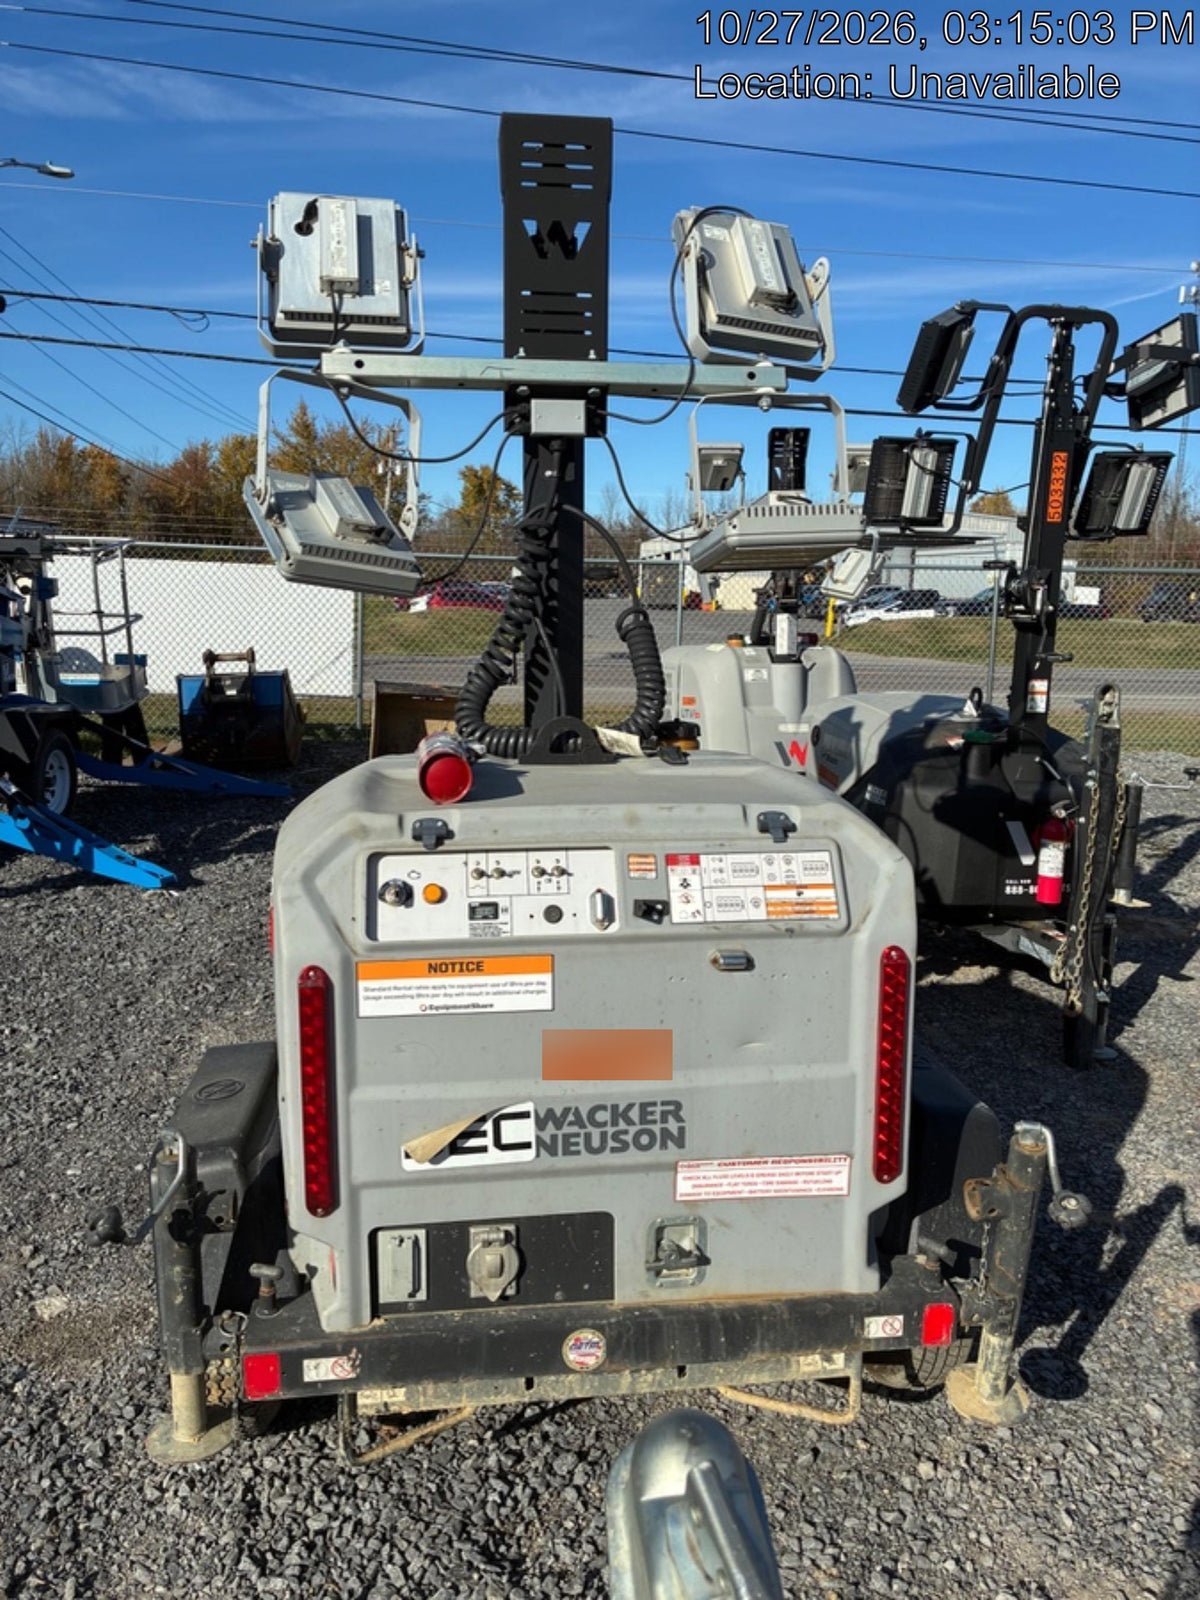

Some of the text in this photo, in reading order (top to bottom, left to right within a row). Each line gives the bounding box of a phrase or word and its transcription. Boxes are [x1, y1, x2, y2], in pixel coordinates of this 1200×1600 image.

[1048, 454, 1067, 520] 503332
[427, 960, 485, 974] NOTICE
[429, 1001, 493, 1011] EquipmentShare
[535, 1100, 686, 1131] WACKER
[536, 1126, 686, 1158] NEUSON
[717, 1159, 768, 1167] CUSTOMER
[770, 1157, 847, 1165] RESPONSIBILITY
